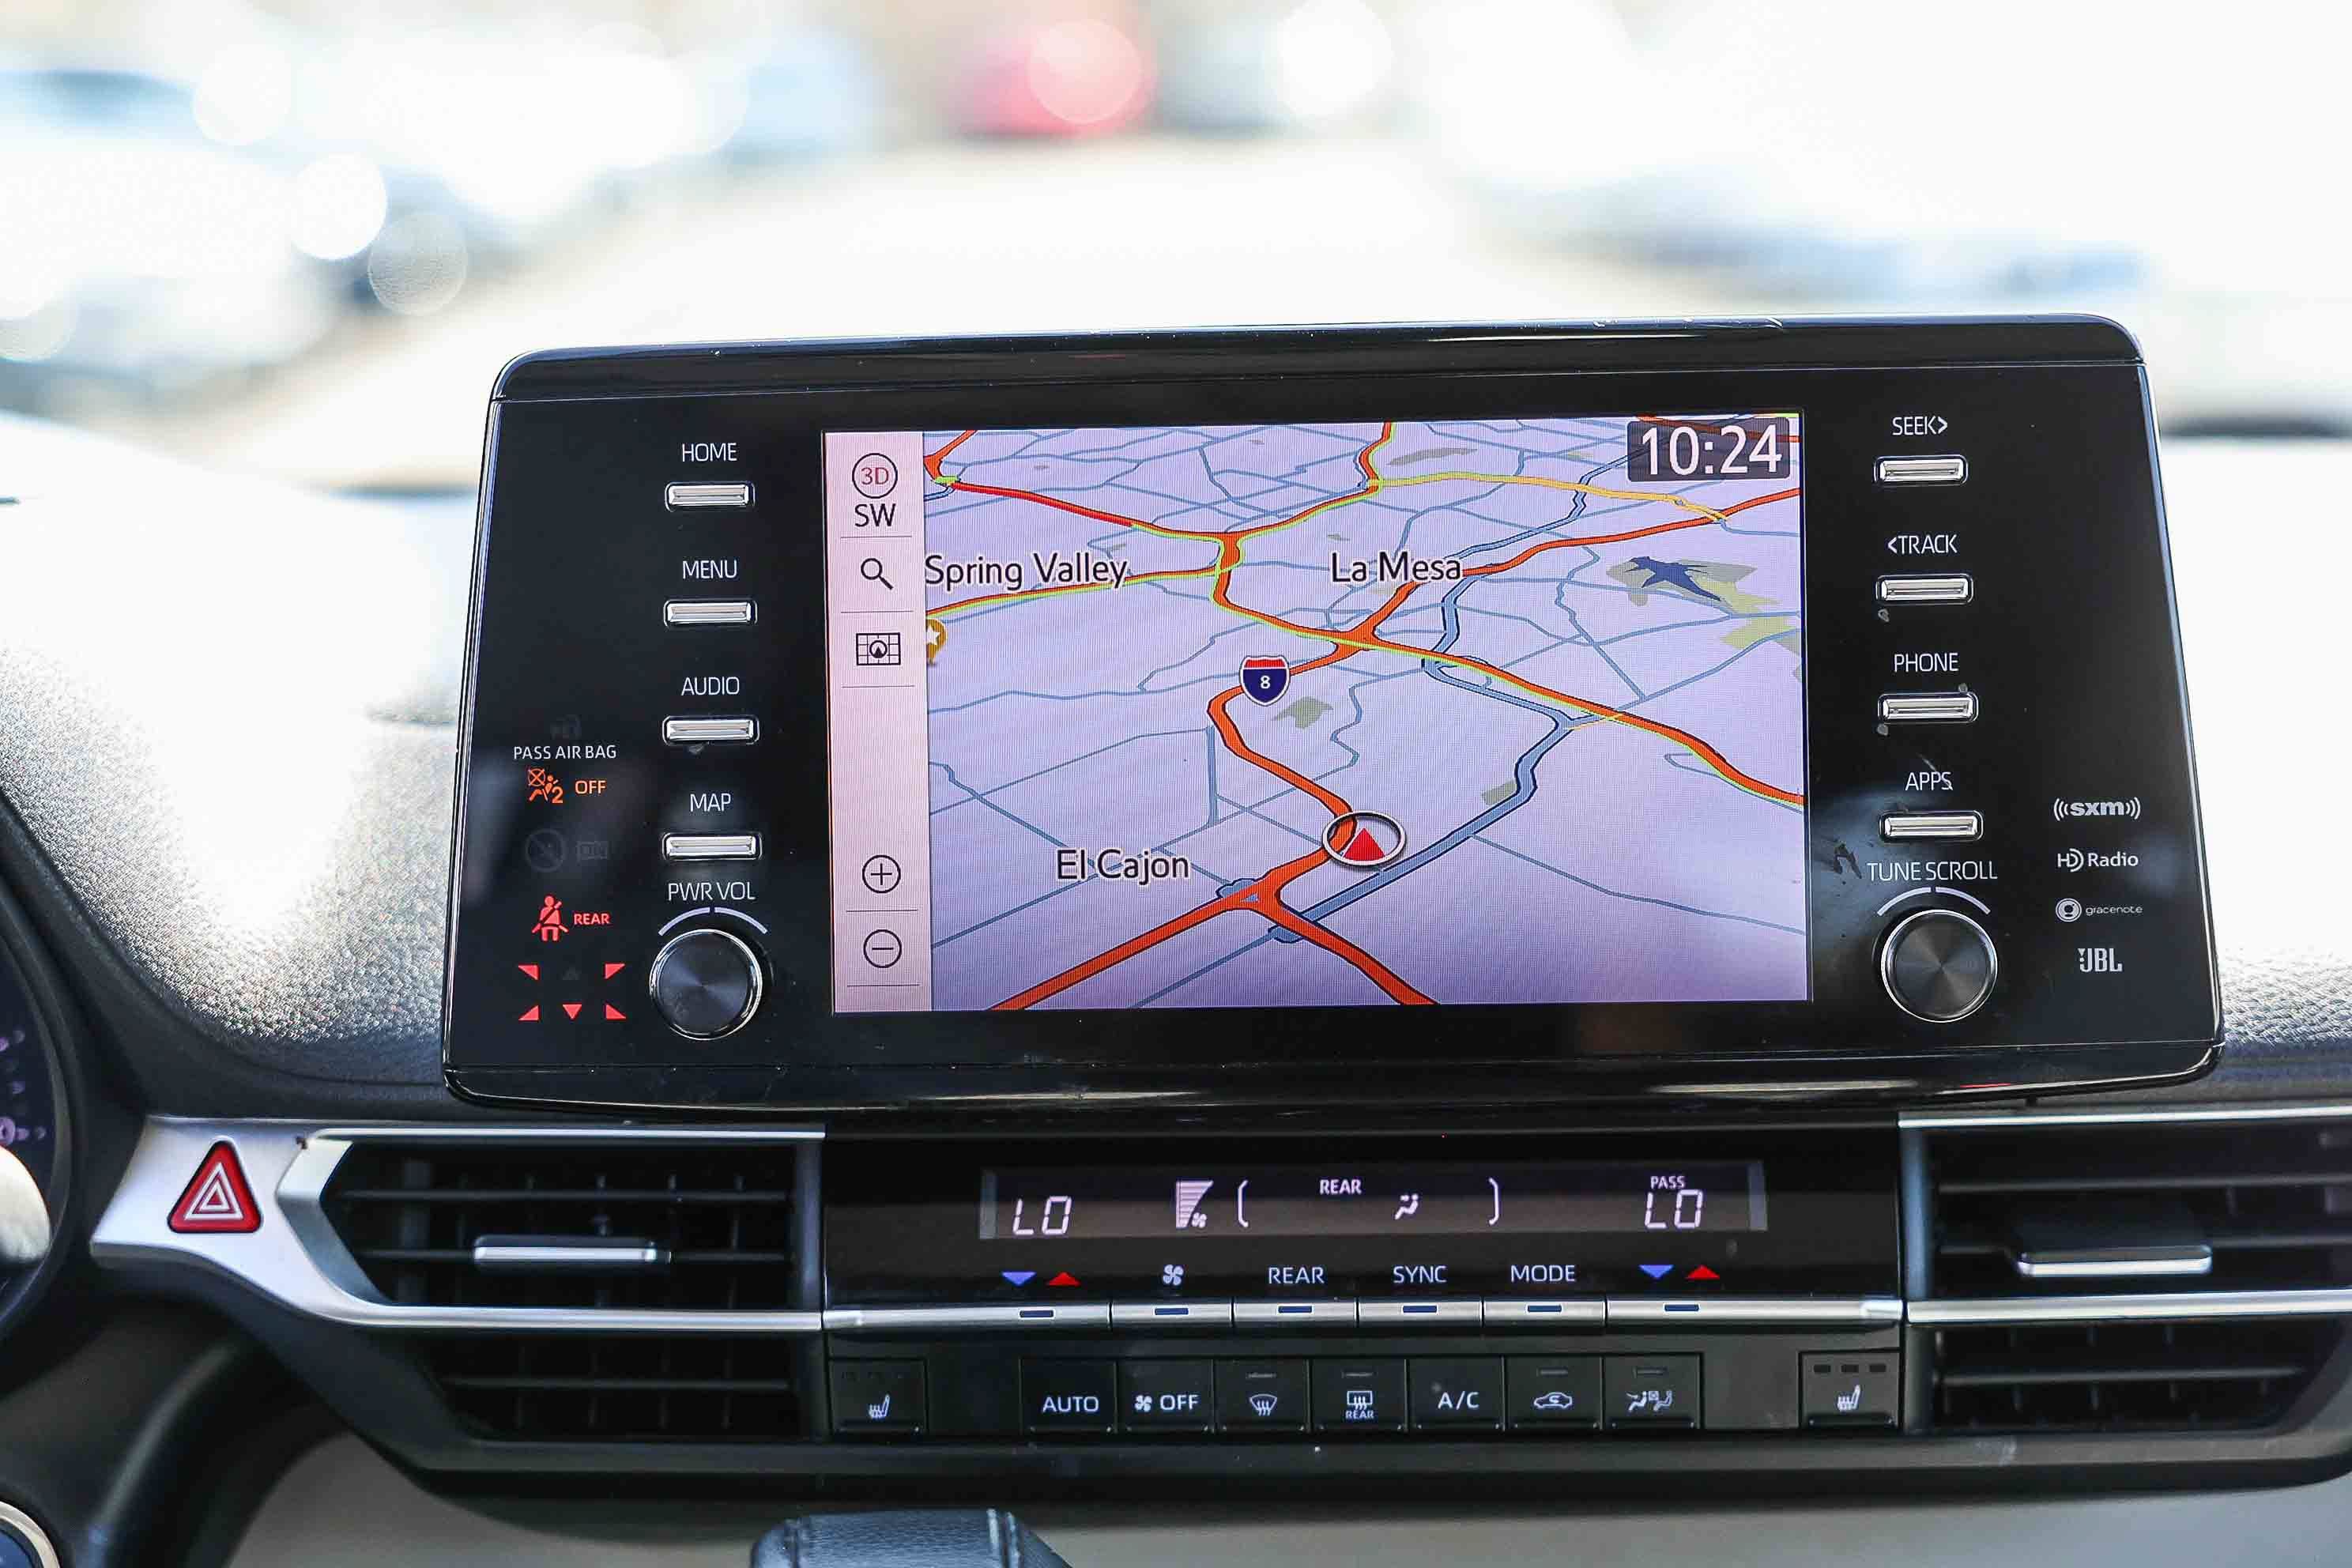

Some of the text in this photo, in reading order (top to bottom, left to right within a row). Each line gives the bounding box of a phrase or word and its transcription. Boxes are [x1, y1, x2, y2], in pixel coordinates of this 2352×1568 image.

[681, 442, 737, 462] HOME
[1641, 424, 1783, 476] 10:24
[861, 466, 889, 485] 3D
[854, 503, 896, 528] SW
[682, 560, 737, 580] MENU
[925, 552, 1128, 590] Spring Valley
[1332, 552, 1462, 583] La Mesa
[1894, 652, 1958, 672] PHONE
[681, 676, 741, 695] AUDIO
[1260, 675, 1270, 689] 8
[514, 744, 616, 760] PASS AIR BAG
[575, 780, 606, 794] OFF
[1905, 771, 1953, 791] APPS
[689, 793, 731, 812] MAP
[1057, 849, 1189, 884] El Cajon
[2088, 852, 2139, 867] Radio
[1867, 861, 1998, 880] TUNE SCROLL
[668, 883, 755, 901] PWR VOL
[574, 913, 610, 925] REAR
[2086, 906, 2143, 916] gracenote
[2078, 948, 2123, 972] JBL
[1320, 1178, 1362, 1195] REAR
[1650, 1176, 1686, 1189] PASS
[1268, 1266, 1325, 1284] REAR
[1393, 1265, 1447, 1284] SYNC
[1510, 1264, 1576, 1283] MODE
[1042, 1396, 1099, 1413] AUTO
[1159, 1394, 1200, 1411] OFF
[1438, 1390, 1479, 1410] A/C
[1345, 1409, 1374, 1419] REAR
